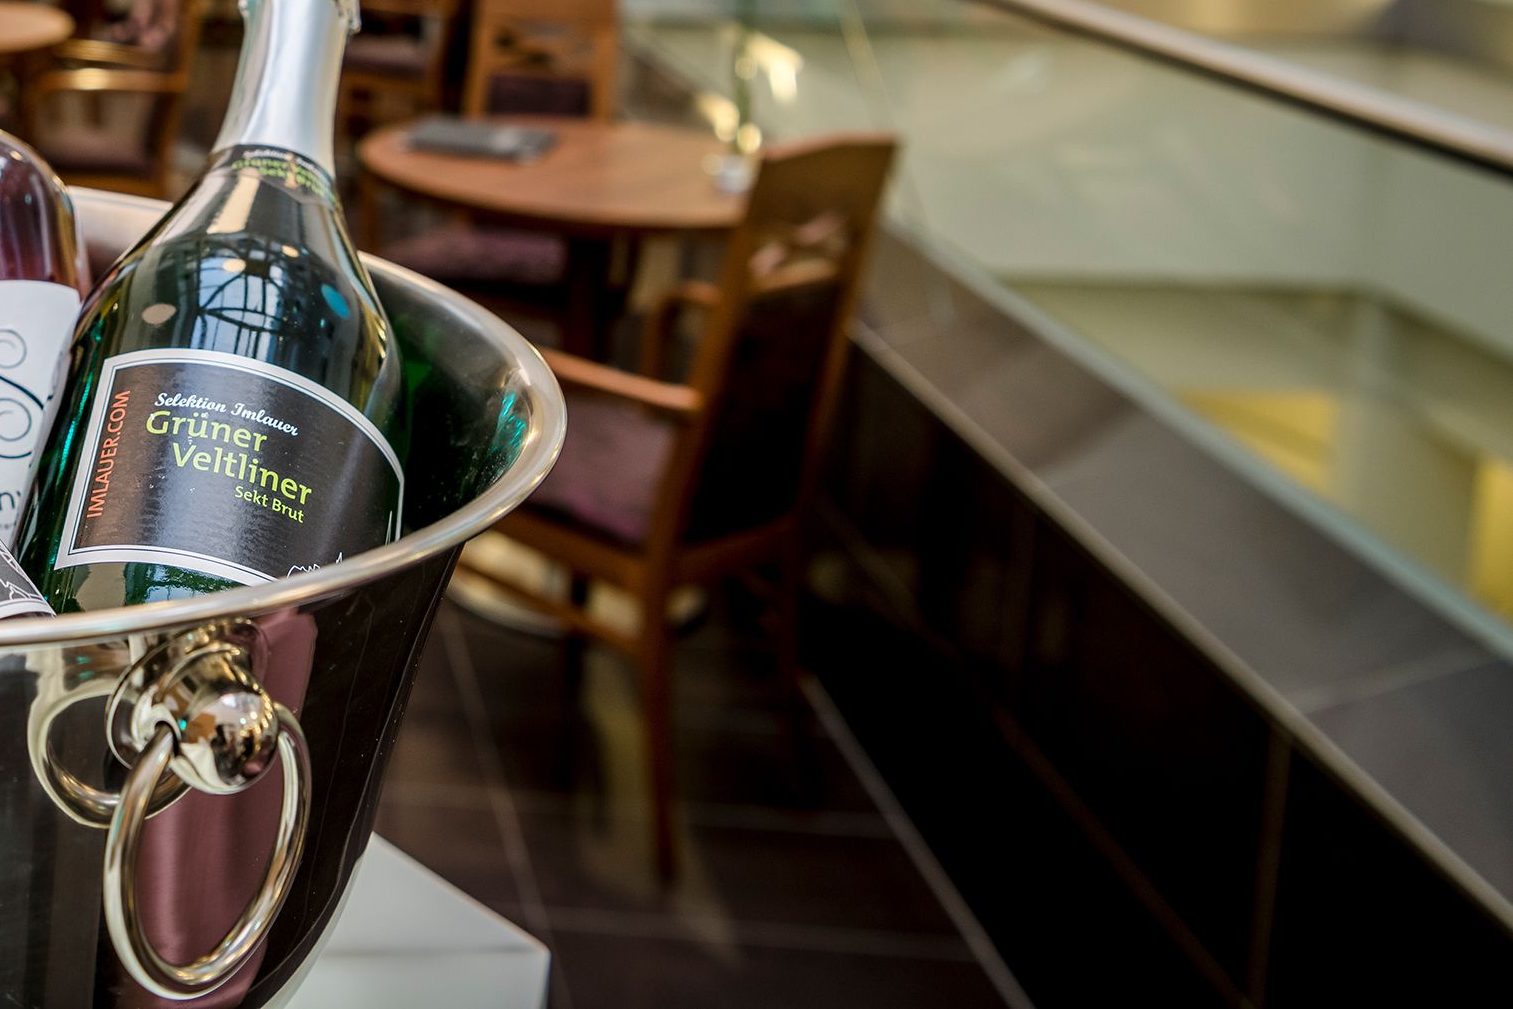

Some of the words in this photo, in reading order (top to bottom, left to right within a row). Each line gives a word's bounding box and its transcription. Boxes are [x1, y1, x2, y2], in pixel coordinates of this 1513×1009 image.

[145, 410, 268, 452] Grüner
[154, 392, 227, 412] Selektion
[231, 402, 299, 437] Imlauer
[86, 390, 131, 518] IMLAUER.COM
[172, 442, 312, 505] Veltliner
[234, 486, 269, 508] Sekt
[272, 500, 304, 523] Brut
